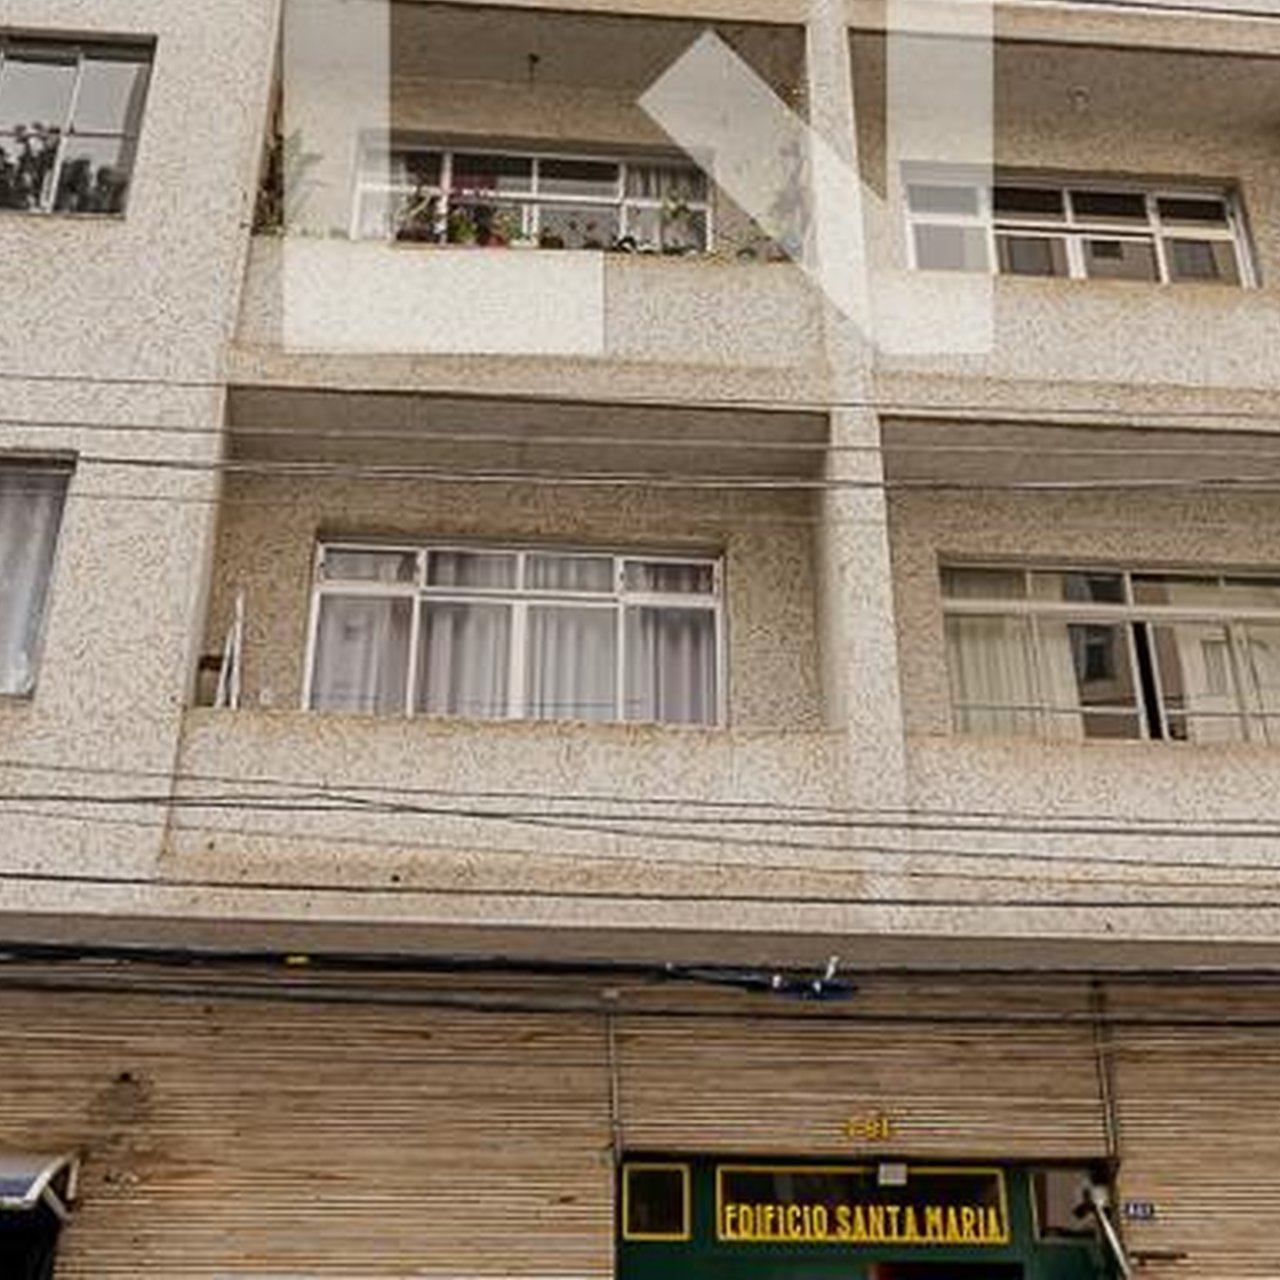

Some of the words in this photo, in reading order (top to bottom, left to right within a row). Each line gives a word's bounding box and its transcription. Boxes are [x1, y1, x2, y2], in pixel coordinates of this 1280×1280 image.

[725, 1204, 829, 1238] EDIFICIO
[836, 1204, 919, 1240] SANTA
[924, 1205, 1000, 1240] MARIA
